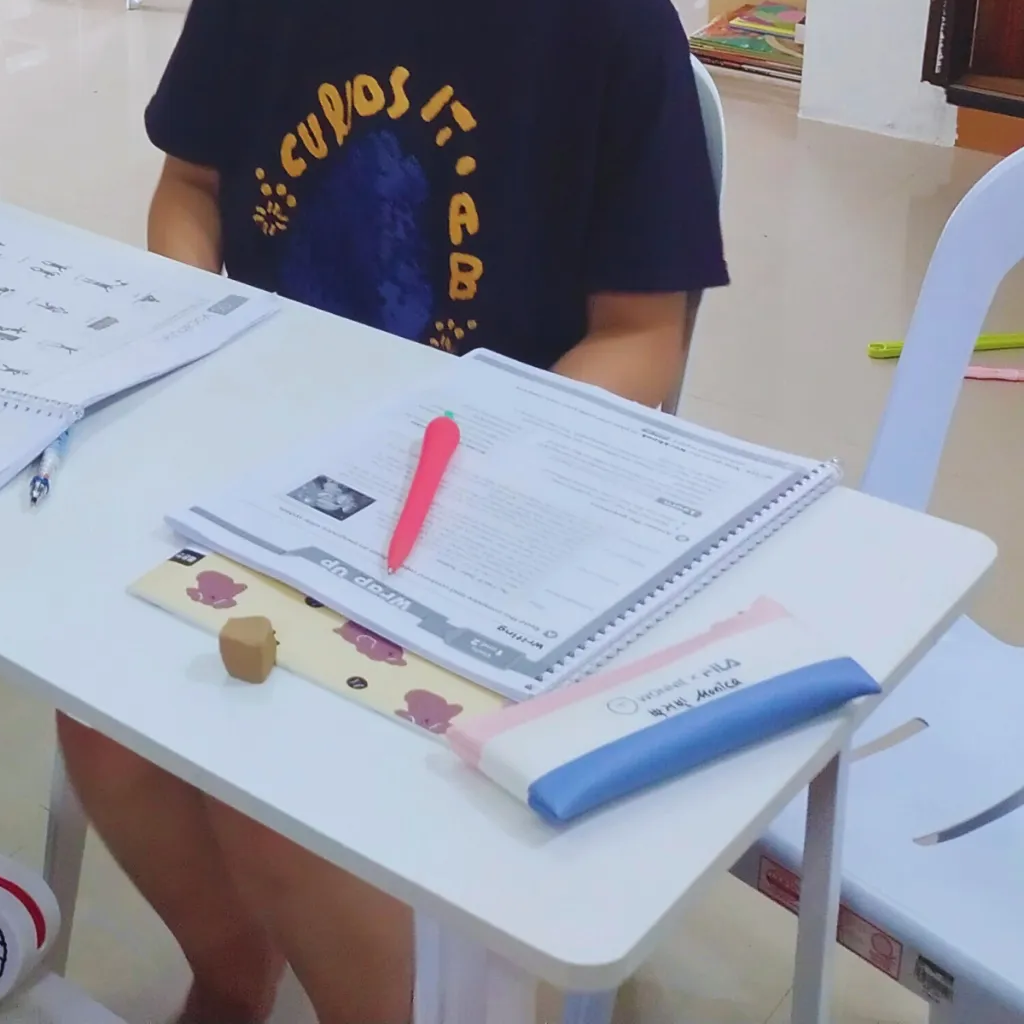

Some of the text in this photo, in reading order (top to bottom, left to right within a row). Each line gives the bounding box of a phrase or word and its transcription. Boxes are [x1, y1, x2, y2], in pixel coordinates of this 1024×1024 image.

[320, 558, 349, 578] Up
[354, 574, 413, 612] Wrap
[496, 624, 544, 650] Writing
[696, 677, 743, 702] Monica
